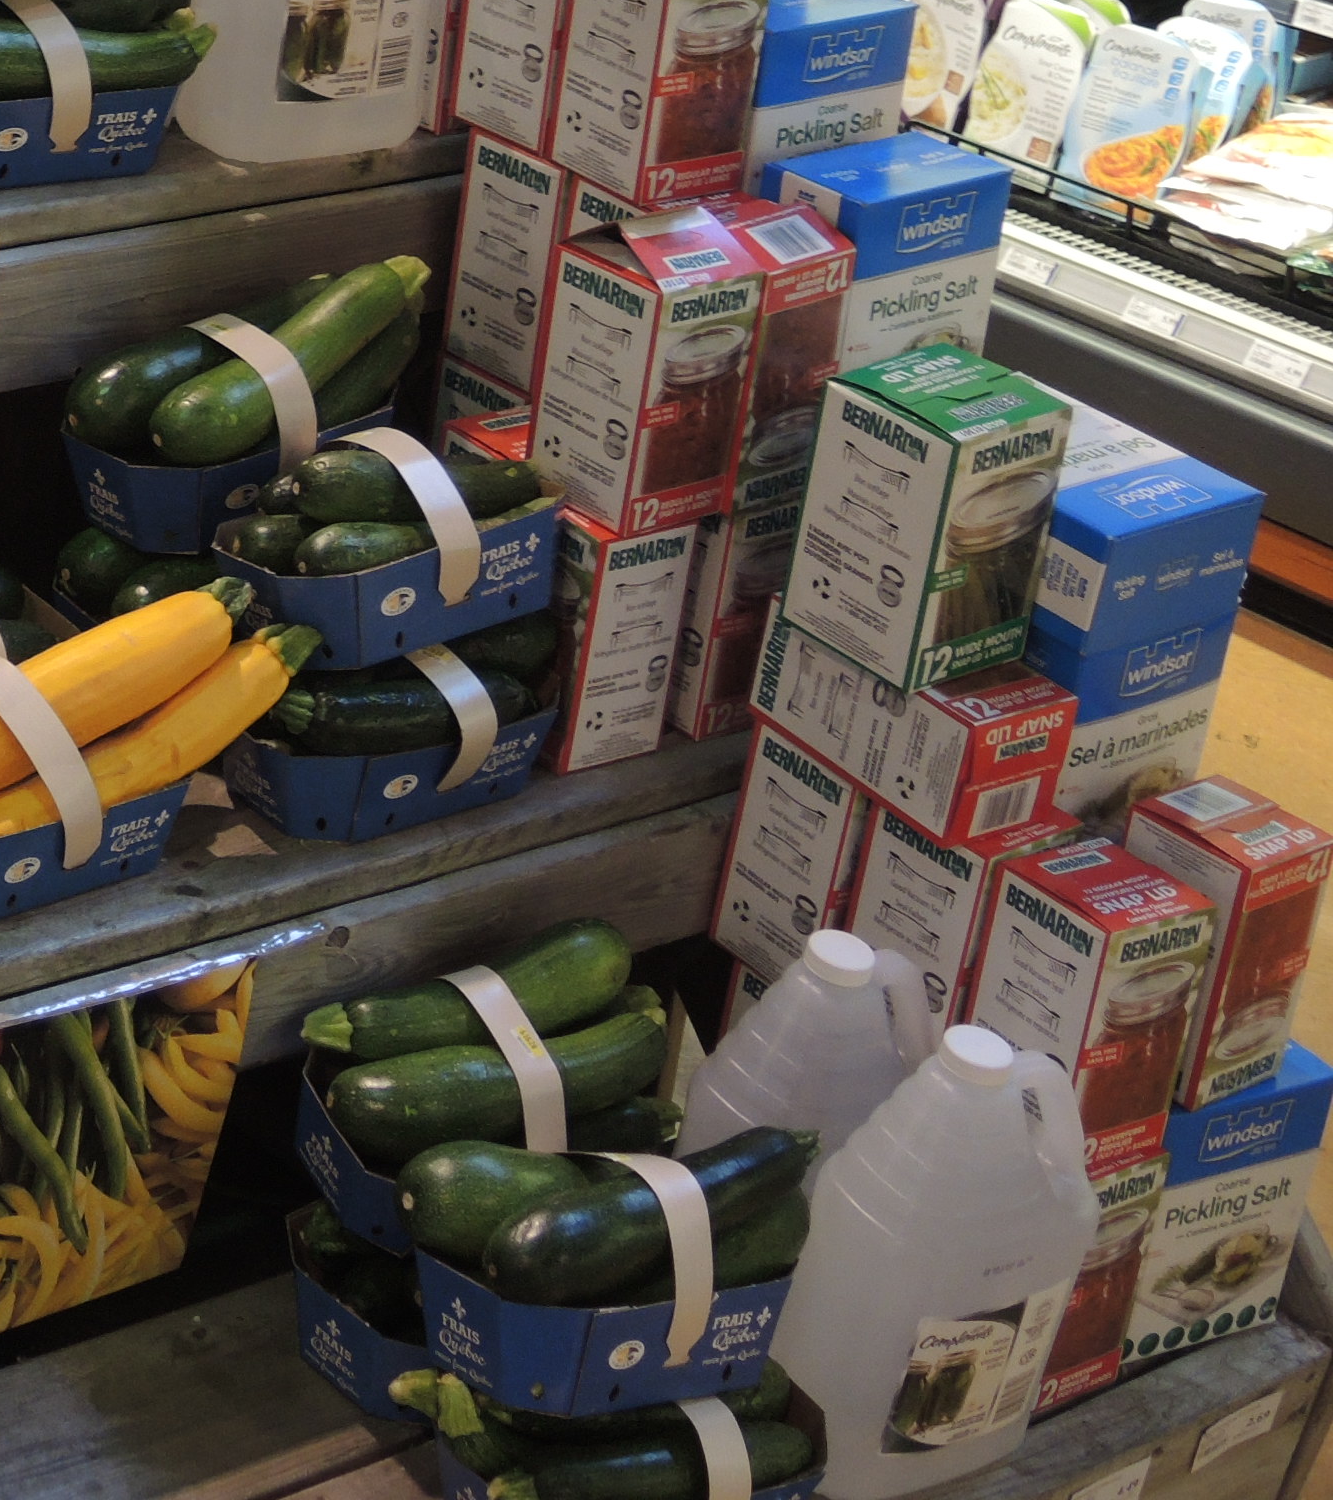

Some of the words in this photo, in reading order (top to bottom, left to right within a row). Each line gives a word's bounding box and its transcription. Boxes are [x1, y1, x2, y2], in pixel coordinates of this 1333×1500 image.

[810, 44, 875, 72] windsor
[97, 109, 137, 125] FRAIS
[776, 117, 846, 149] Pickling
[849, 109, 885, 134] Salt
[97, 125, 146, 143] Québec
[478, 144, 551, 197] BERNARDIN
[647, 168, 676, 198] 12
[901, 210, 968, 241] windsor
[563, 262, 646, 321] BERNARDIN
[671, 287, 749, 323] BERNARDIN
[869, 289, 938, 323] Pickling
[942, 274, 978, 302] Salt
[841, 399, 928, 463] BERNARDIN
[971, 428, 1055, 475] BERNARDIN
[634, 497, 660, 530] 12
[481, 539, 521, 564] FRAIS
[608, 535, 687, 571] BERNARDIN
[921, 645, 953, 685] 12
[1126, 651, 1193, 686] windsor
[985, 724, 1012, 746] LID
[1015, 709, 1064, 737] SNAP
[1069, 744, 1101, 768] Sel
[1102, 736, 1116, 760] à
[1118, 708, 1209, 753] marinades
[761, 735, 843, 806] BERNARDIN
[110, 817, 151, 839] FRAIS
[1243, 839, 1284, 860] SNAP
[1286, 827, 1317, 845] LID
[1092, 892, 1144, 914] SNAP
[1147, 885, 1177, 903] LID
[1005, 883, 1095, 958] BERNARDIN
[1119, 922, 1203, 964] BERNARDIN
[1206, 1117, 1282, 1150] windsor
[1216, 1176, 1252, 1194] Coarse
[1164, 1194, 1249, 1230] Pickling
[1253, 1177, 1292, 1207] Salt
[711, 1310, 754, 1331] FRAIS
[711, 1327, 760, 1352] Québec
